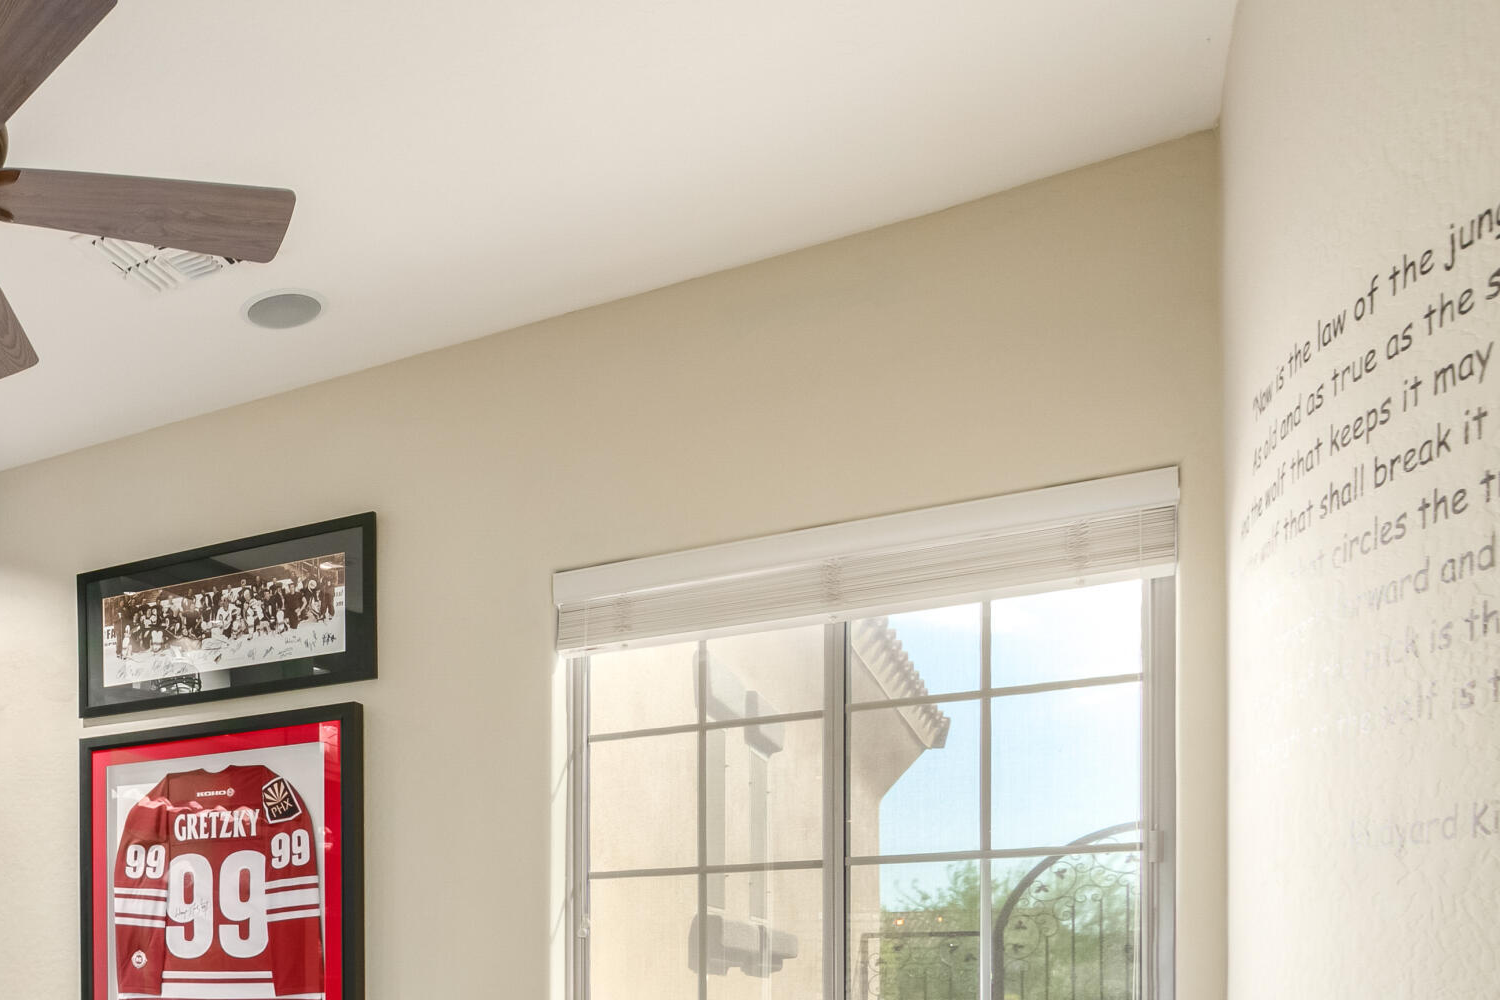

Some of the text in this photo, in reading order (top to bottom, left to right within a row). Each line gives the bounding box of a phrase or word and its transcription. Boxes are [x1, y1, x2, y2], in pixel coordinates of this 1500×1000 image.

[1276, 366, 1285, 392] is
[1287, 341, 1312, 378] the
[1316, 309, 1347, 352] law
[1354, 274, 1379, 321] of
[1388, 249, 1435, 296] the
[1280, 392, 1302, 440] and
[1306, 383, 1325, 416] as
[1331, 348, 1378, 397] true
[1386, 322, 1413, 361] as
[1423, 292, 1475, 336] the
[1289, 437, 1323, 485] that
[1329, 396, 1393, 457] keeps
[1403, 375, 1423, 413] it
[1433, 341, 1495, 396] may
[1283, 499, 1315, 546] that
[1319, 463, 1365, 520] shall
[1373, 422, 1452, 489] break
[1464, 406, 1488, 445] it
[1331, 511, 1408, 569] circles
[1417, 487, 1469, 530] the
[1439, 530, 1496, 584] and
[1430, 618, 1454, 654] is
[196, 789, 226, 798] KOHO
[270, 797, 293, 819] PHX
[173, 808, 260, 842] GRETZKY
[271, 828, 311, 870] 99
[124, 844, 166, 879] 99
[165, 849, 269, 959] 99
